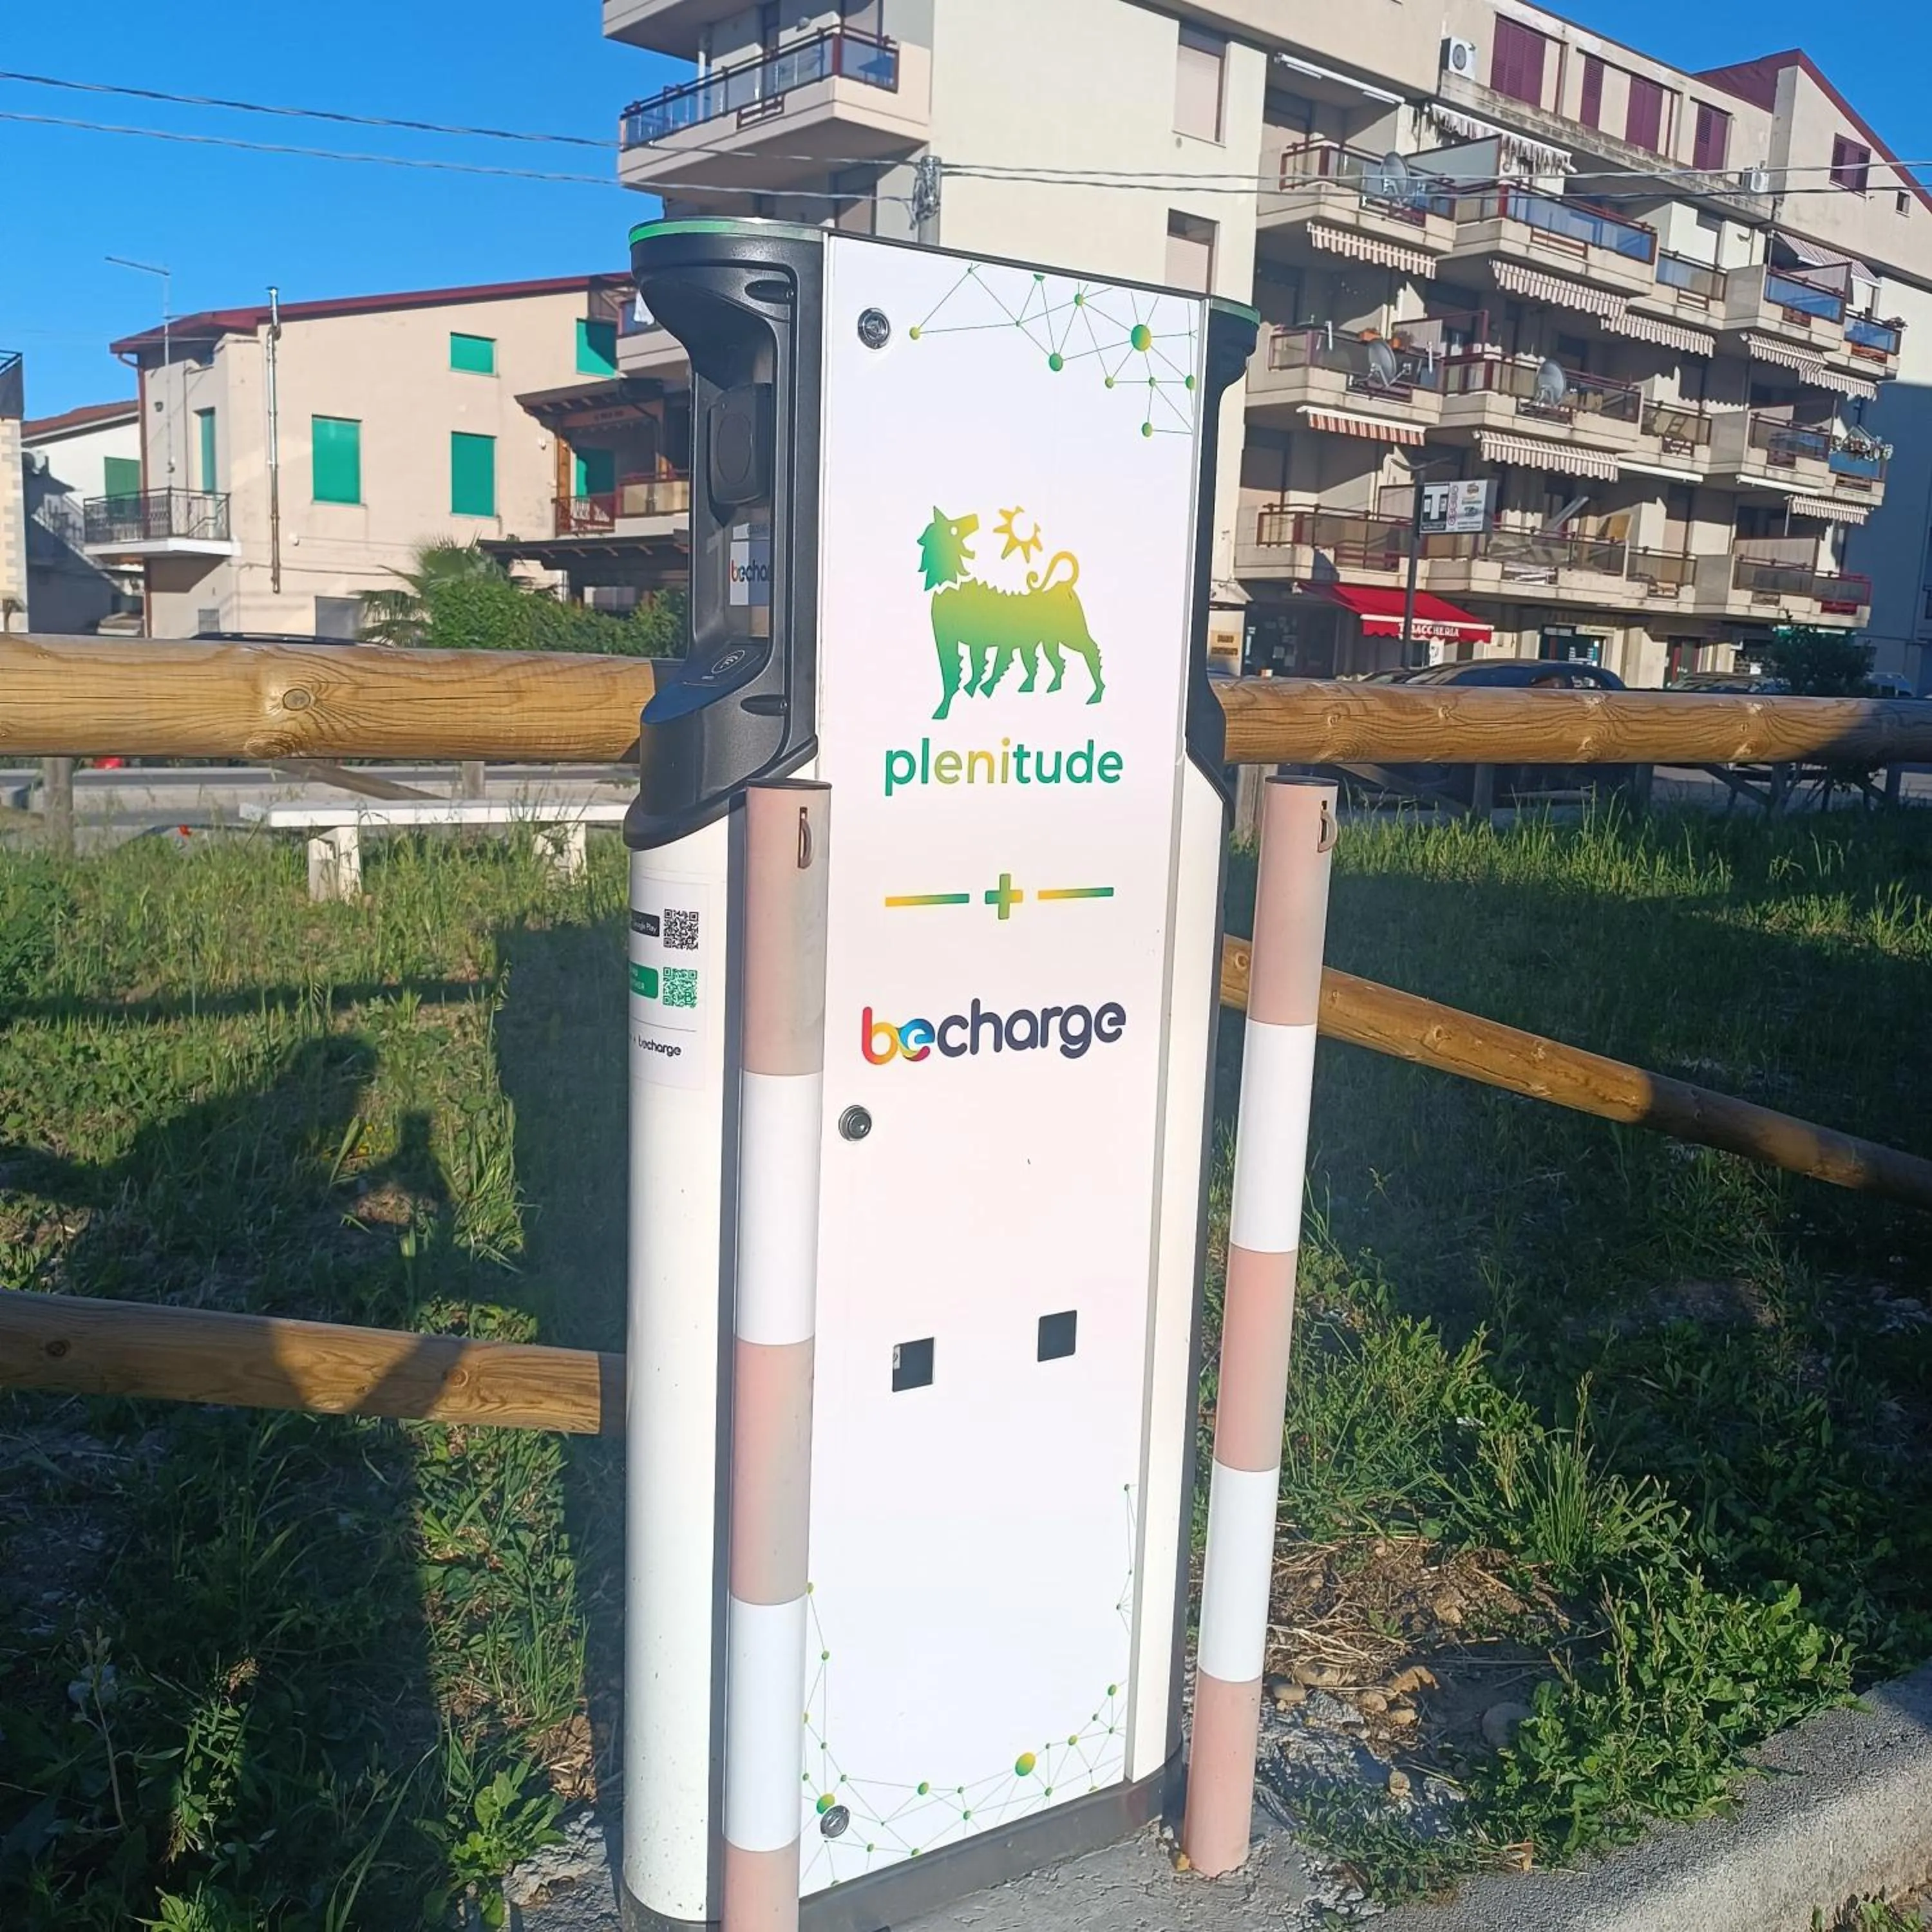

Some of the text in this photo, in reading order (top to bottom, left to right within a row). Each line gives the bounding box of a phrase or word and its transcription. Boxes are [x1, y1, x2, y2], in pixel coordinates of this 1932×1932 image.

[1398, 623, 1459, 637] TBACCHERIA
[884, 737, 1123, 796] plenitude
[861, 998, 1126, 1065] becharge
